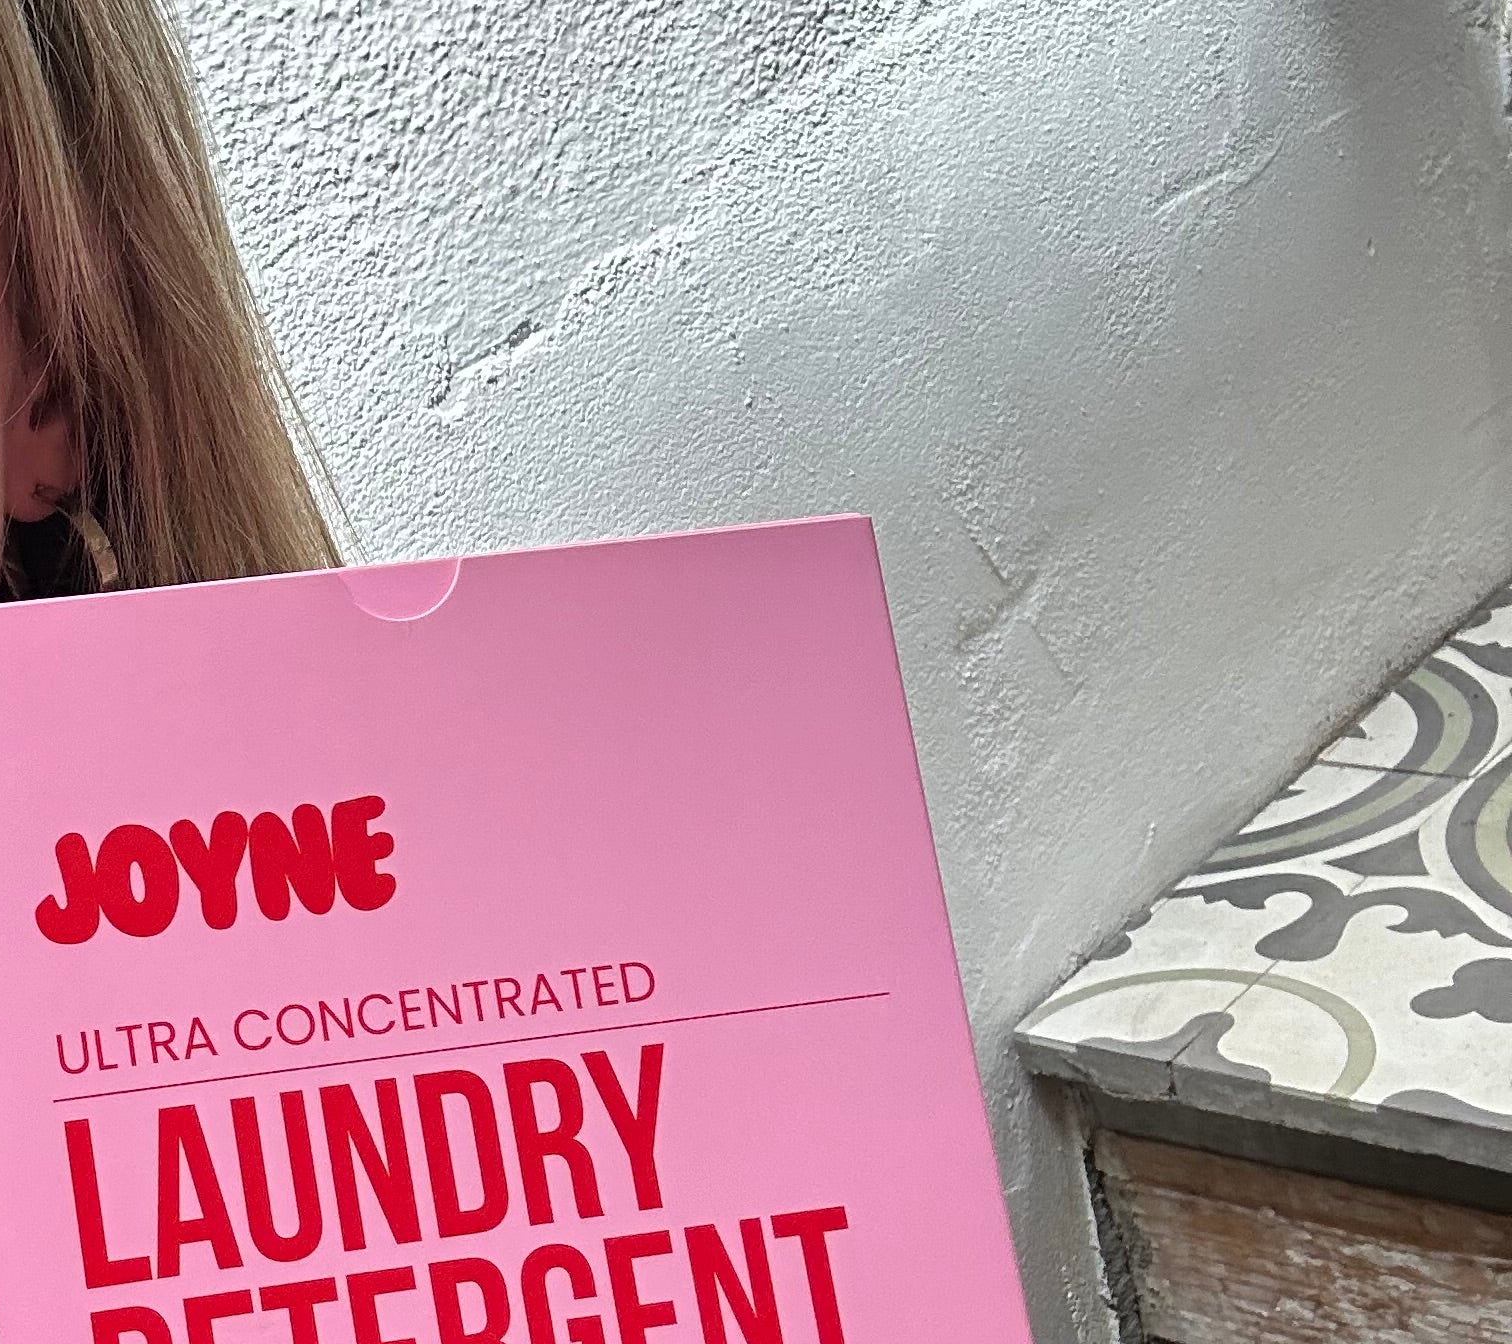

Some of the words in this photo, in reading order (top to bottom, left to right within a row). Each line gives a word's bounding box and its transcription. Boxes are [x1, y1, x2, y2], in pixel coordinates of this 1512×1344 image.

[34, 795, 397, 945] JOYNE
[55, 1016, 219, 1075] ULTRA
[232, 960, 657, 1052] CONCENTRATED
[63, 1042, 665, 1290] LAUNDRY
